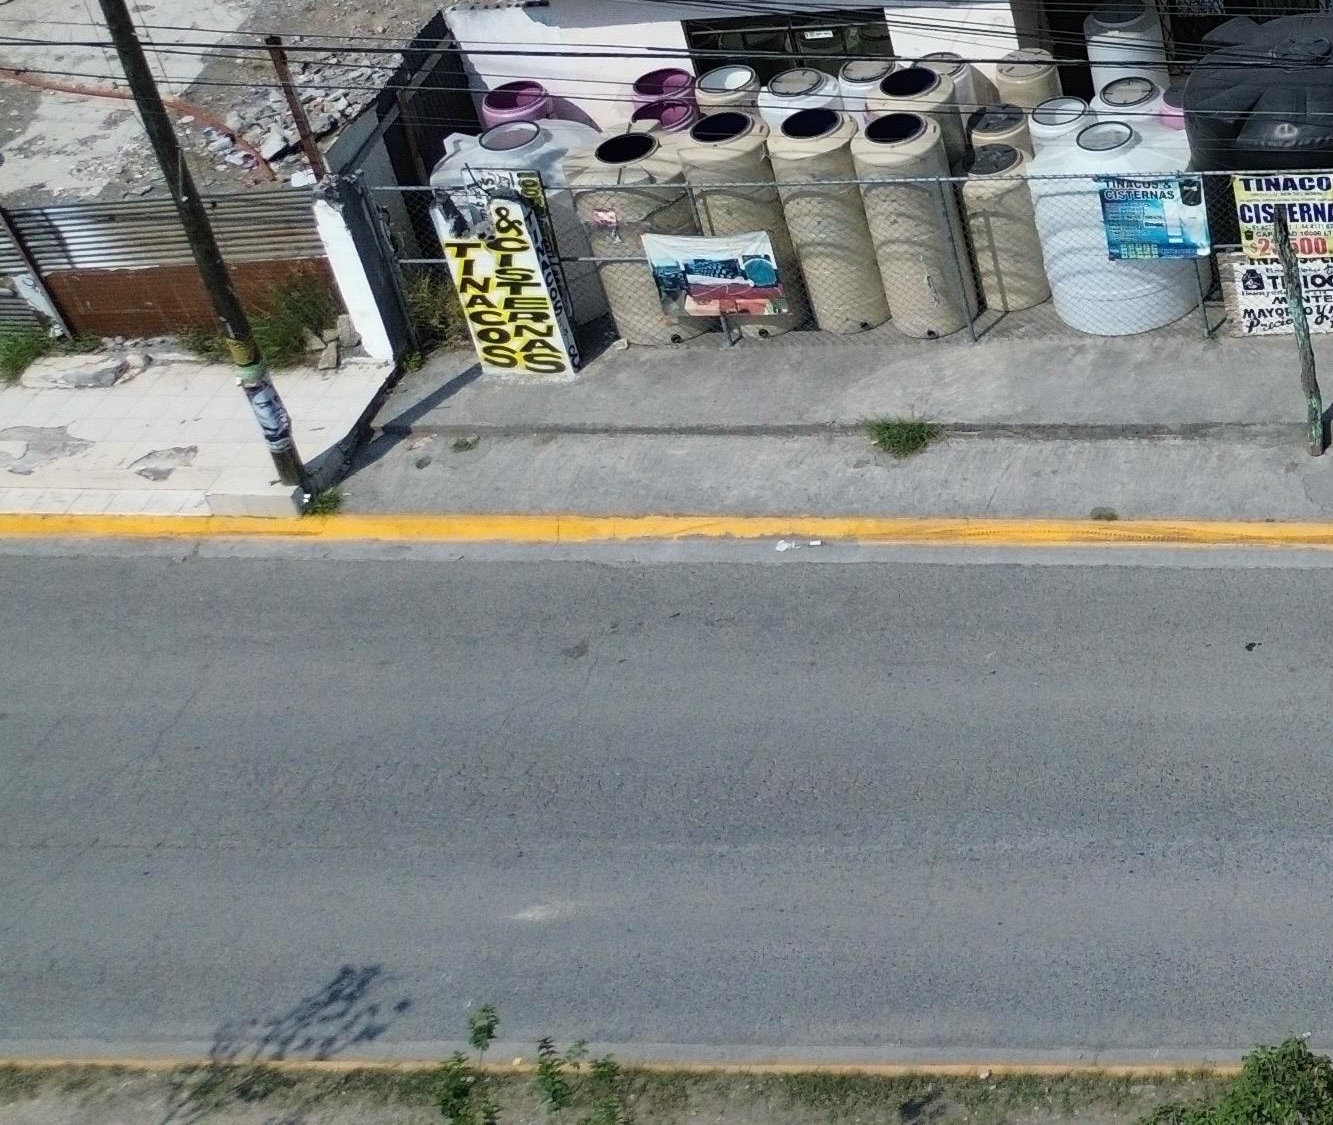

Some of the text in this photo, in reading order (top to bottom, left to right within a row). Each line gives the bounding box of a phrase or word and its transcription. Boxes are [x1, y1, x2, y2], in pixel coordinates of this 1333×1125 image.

[1104, 190, 1175, 201] CISTERNAS
[1105, 180, 1160, 190] TINACOS
[1239, 176, 1332, 192] TINACO
[495, 206, 524, 237] &
[445, 242, 519, 369] TINACOS
[486, 237, 567, 374] CISTERNAS
